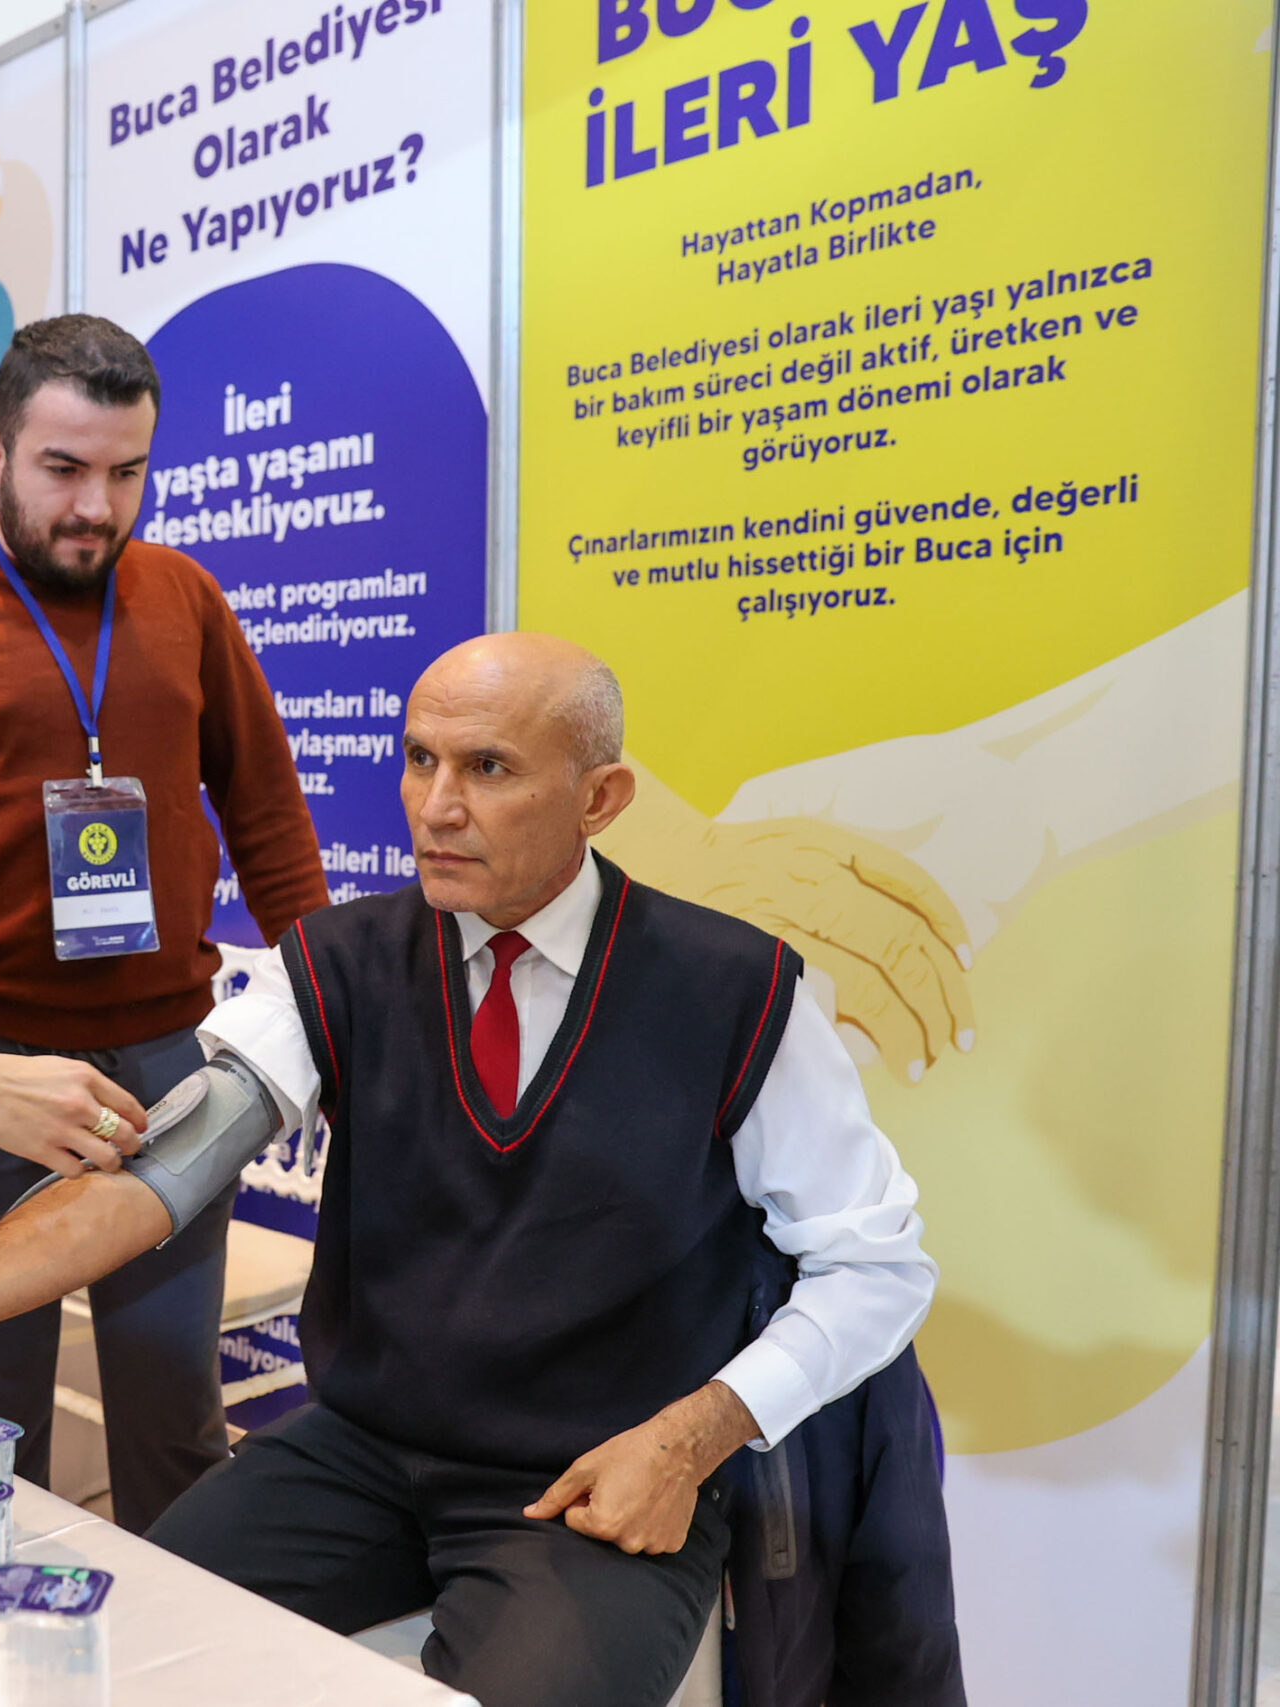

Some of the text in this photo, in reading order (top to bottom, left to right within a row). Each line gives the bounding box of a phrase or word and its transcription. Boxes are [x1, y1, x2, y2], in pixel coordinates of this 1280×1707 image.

[110, 84, 198, 147] Buca
[585, 15, 812, 188] İLERİ
[847, 0, 1089, 104] YAŞ
[193, 94, 330, 179] Olarak
[121, 132, 424, 275] Ne Yapıyoruz?
[682, 169, 982, 257] Hayattan Kopmadan,
[717, 219, 936, 285] Hayatla Birlikte
[567, 257, 1152, 387] Buca Belediyesi olarak ileri yaşı yalnızca
[574, 304, 1138, 420] bir bakım süreci değil aktif, üretken ve
[223, 381, 292, 436] İleri
[617, 354, 1066, 449] keyifli bir yaşam dönemi olarak
[152, 432, 374, 508] yaşta yaşamı
[742, 428, 897, 472] görüyoruz.
[143, 488, 386, 548] destekliyoruz.
[568, 473, 1138, 563] Çınarlarımızın kendini güvende, değerli
[613, 525, 1063, 587] ve mutlu hissettiği bir Buca için
[223, 567, 427, 613] eket programları
[737, 587, 896, 622] çalışıyoruz.
[239, 611, 417, 654] üçlendiriyoruz.
[274, 686, 402, 719] kursları ile
[287, 727, 395, 765] ylaşmayı
[66, 868, 137, 892] GÖREVLİ
[319, 841, 417, 878] zileri ile
